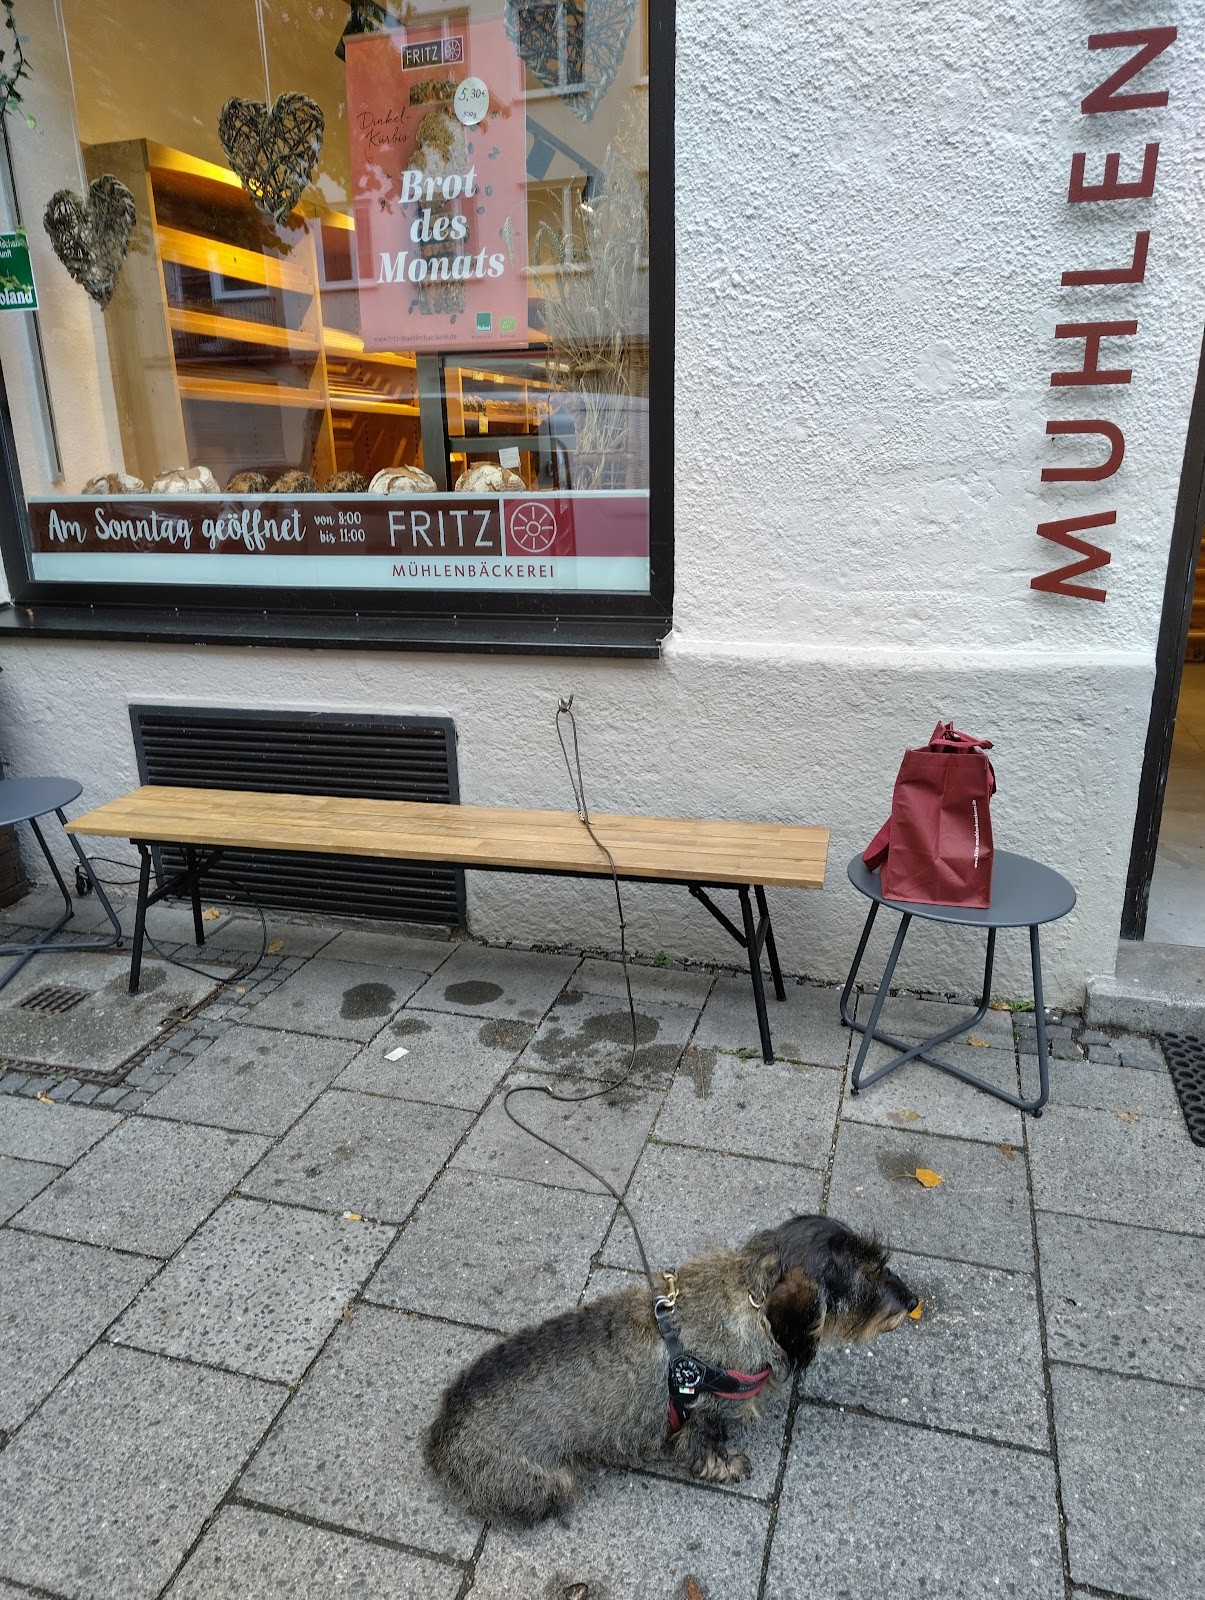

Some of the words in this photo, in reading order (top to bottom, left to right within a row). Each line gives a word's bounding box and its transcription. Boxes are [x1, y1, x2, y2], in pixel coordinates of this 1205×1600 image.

[406, 45, 438, 65] FRITZ
[398, 164, 478, 204] Brot
[410, 208, 467, 243] des
[377, 246, 505, 284] Monats
[49, 508, 87, 543] Am
[95, 507, 193, 550] Sonntag
[201, 508, 307, 551] geöffnet
[314, 513, 334, 526] von
[338, 511, 362, 525] 8:00
[319, 528, 336, 543] bis
[339, 529, 366, 543] 11:00
[388, 509, 494, 547] FRITZ
[392, 560, 555, 578] MÜHLENBÄCKEREI
